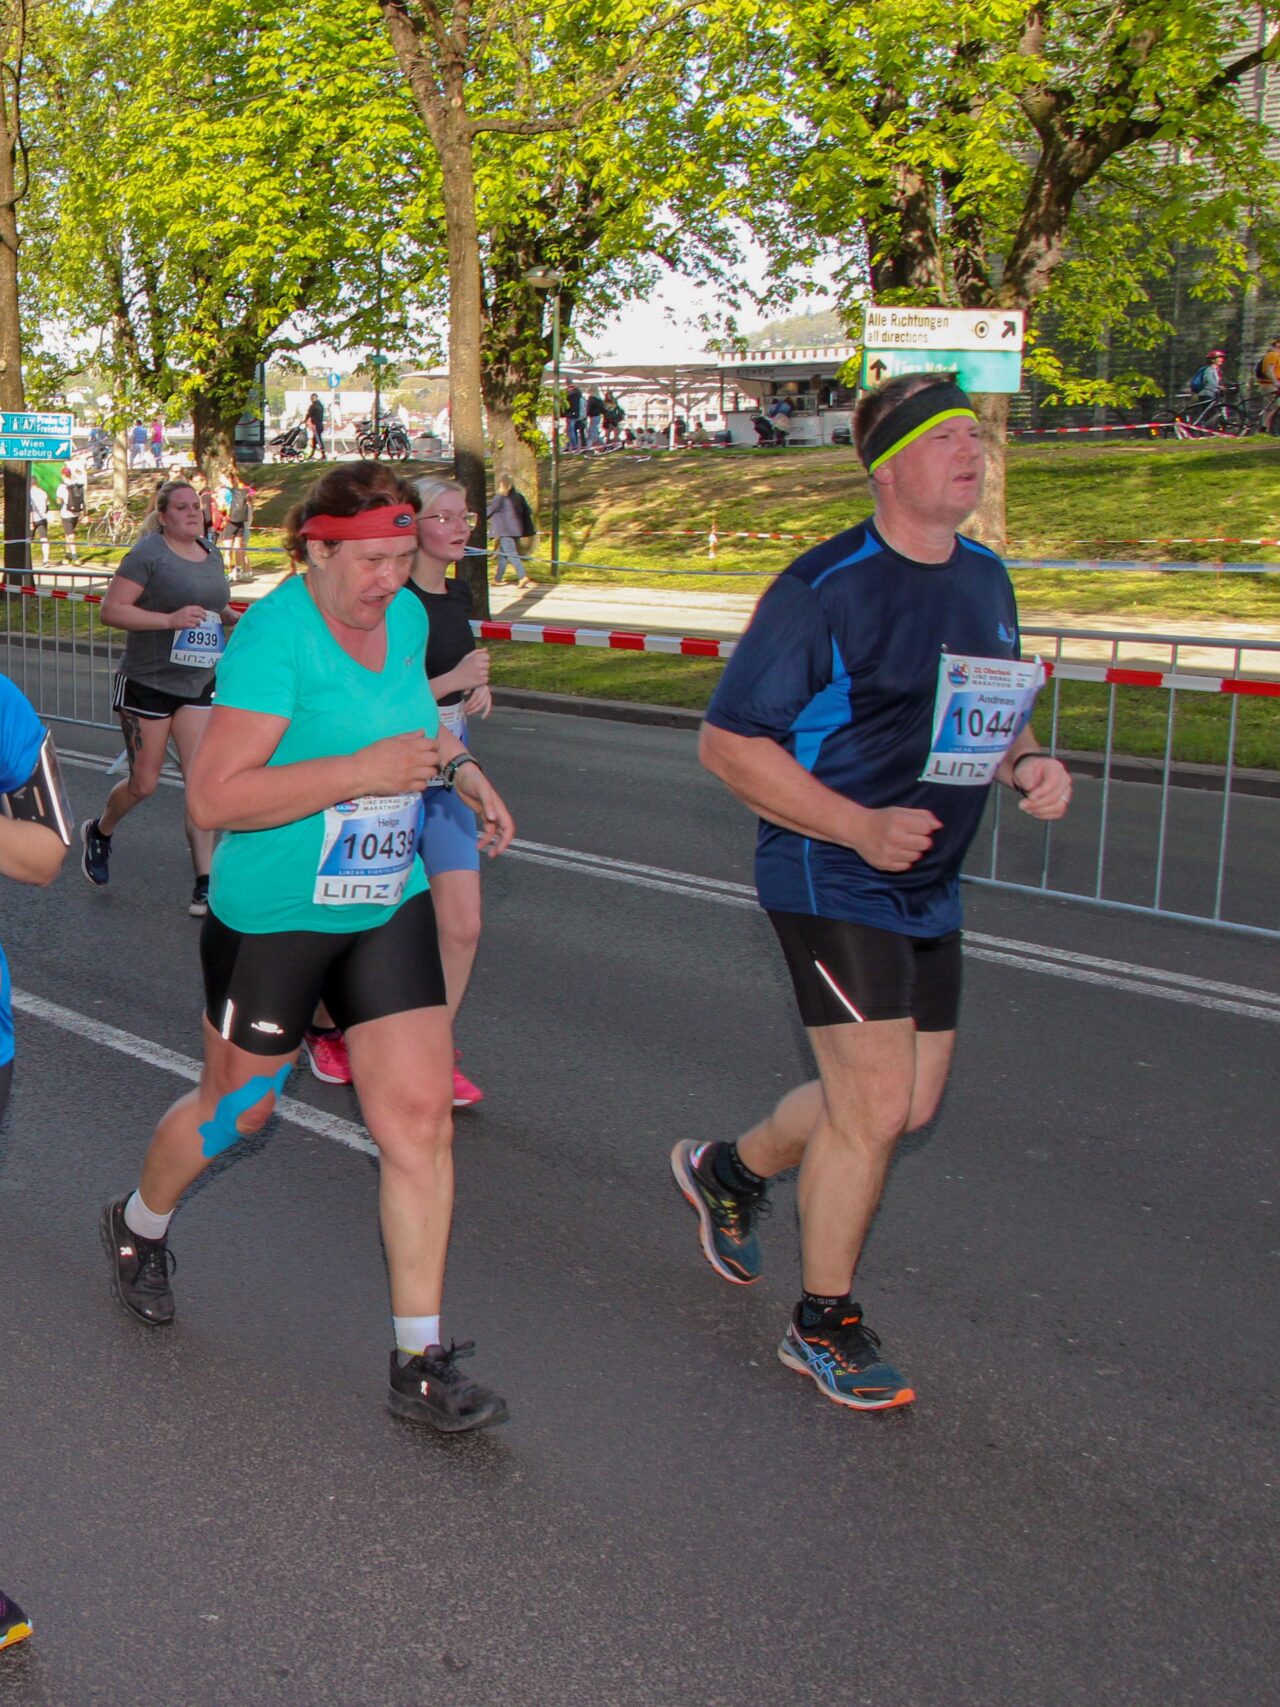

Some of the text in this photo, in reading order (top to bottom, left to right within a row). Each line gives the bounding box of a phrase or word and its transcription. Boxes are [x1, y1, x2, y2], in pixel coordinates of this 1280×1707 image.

[867, 313, 949, 330] Alle Richtungen
[867, 331, 929, 343] all directions
[23, 418, 35, 430] A7
[20, 439, 45, 448] Wien
[13, 448, 53, 459] Salzburg
[187, 630, 218, 647] 8939
[977, 693, 1016, 706] Andreas
